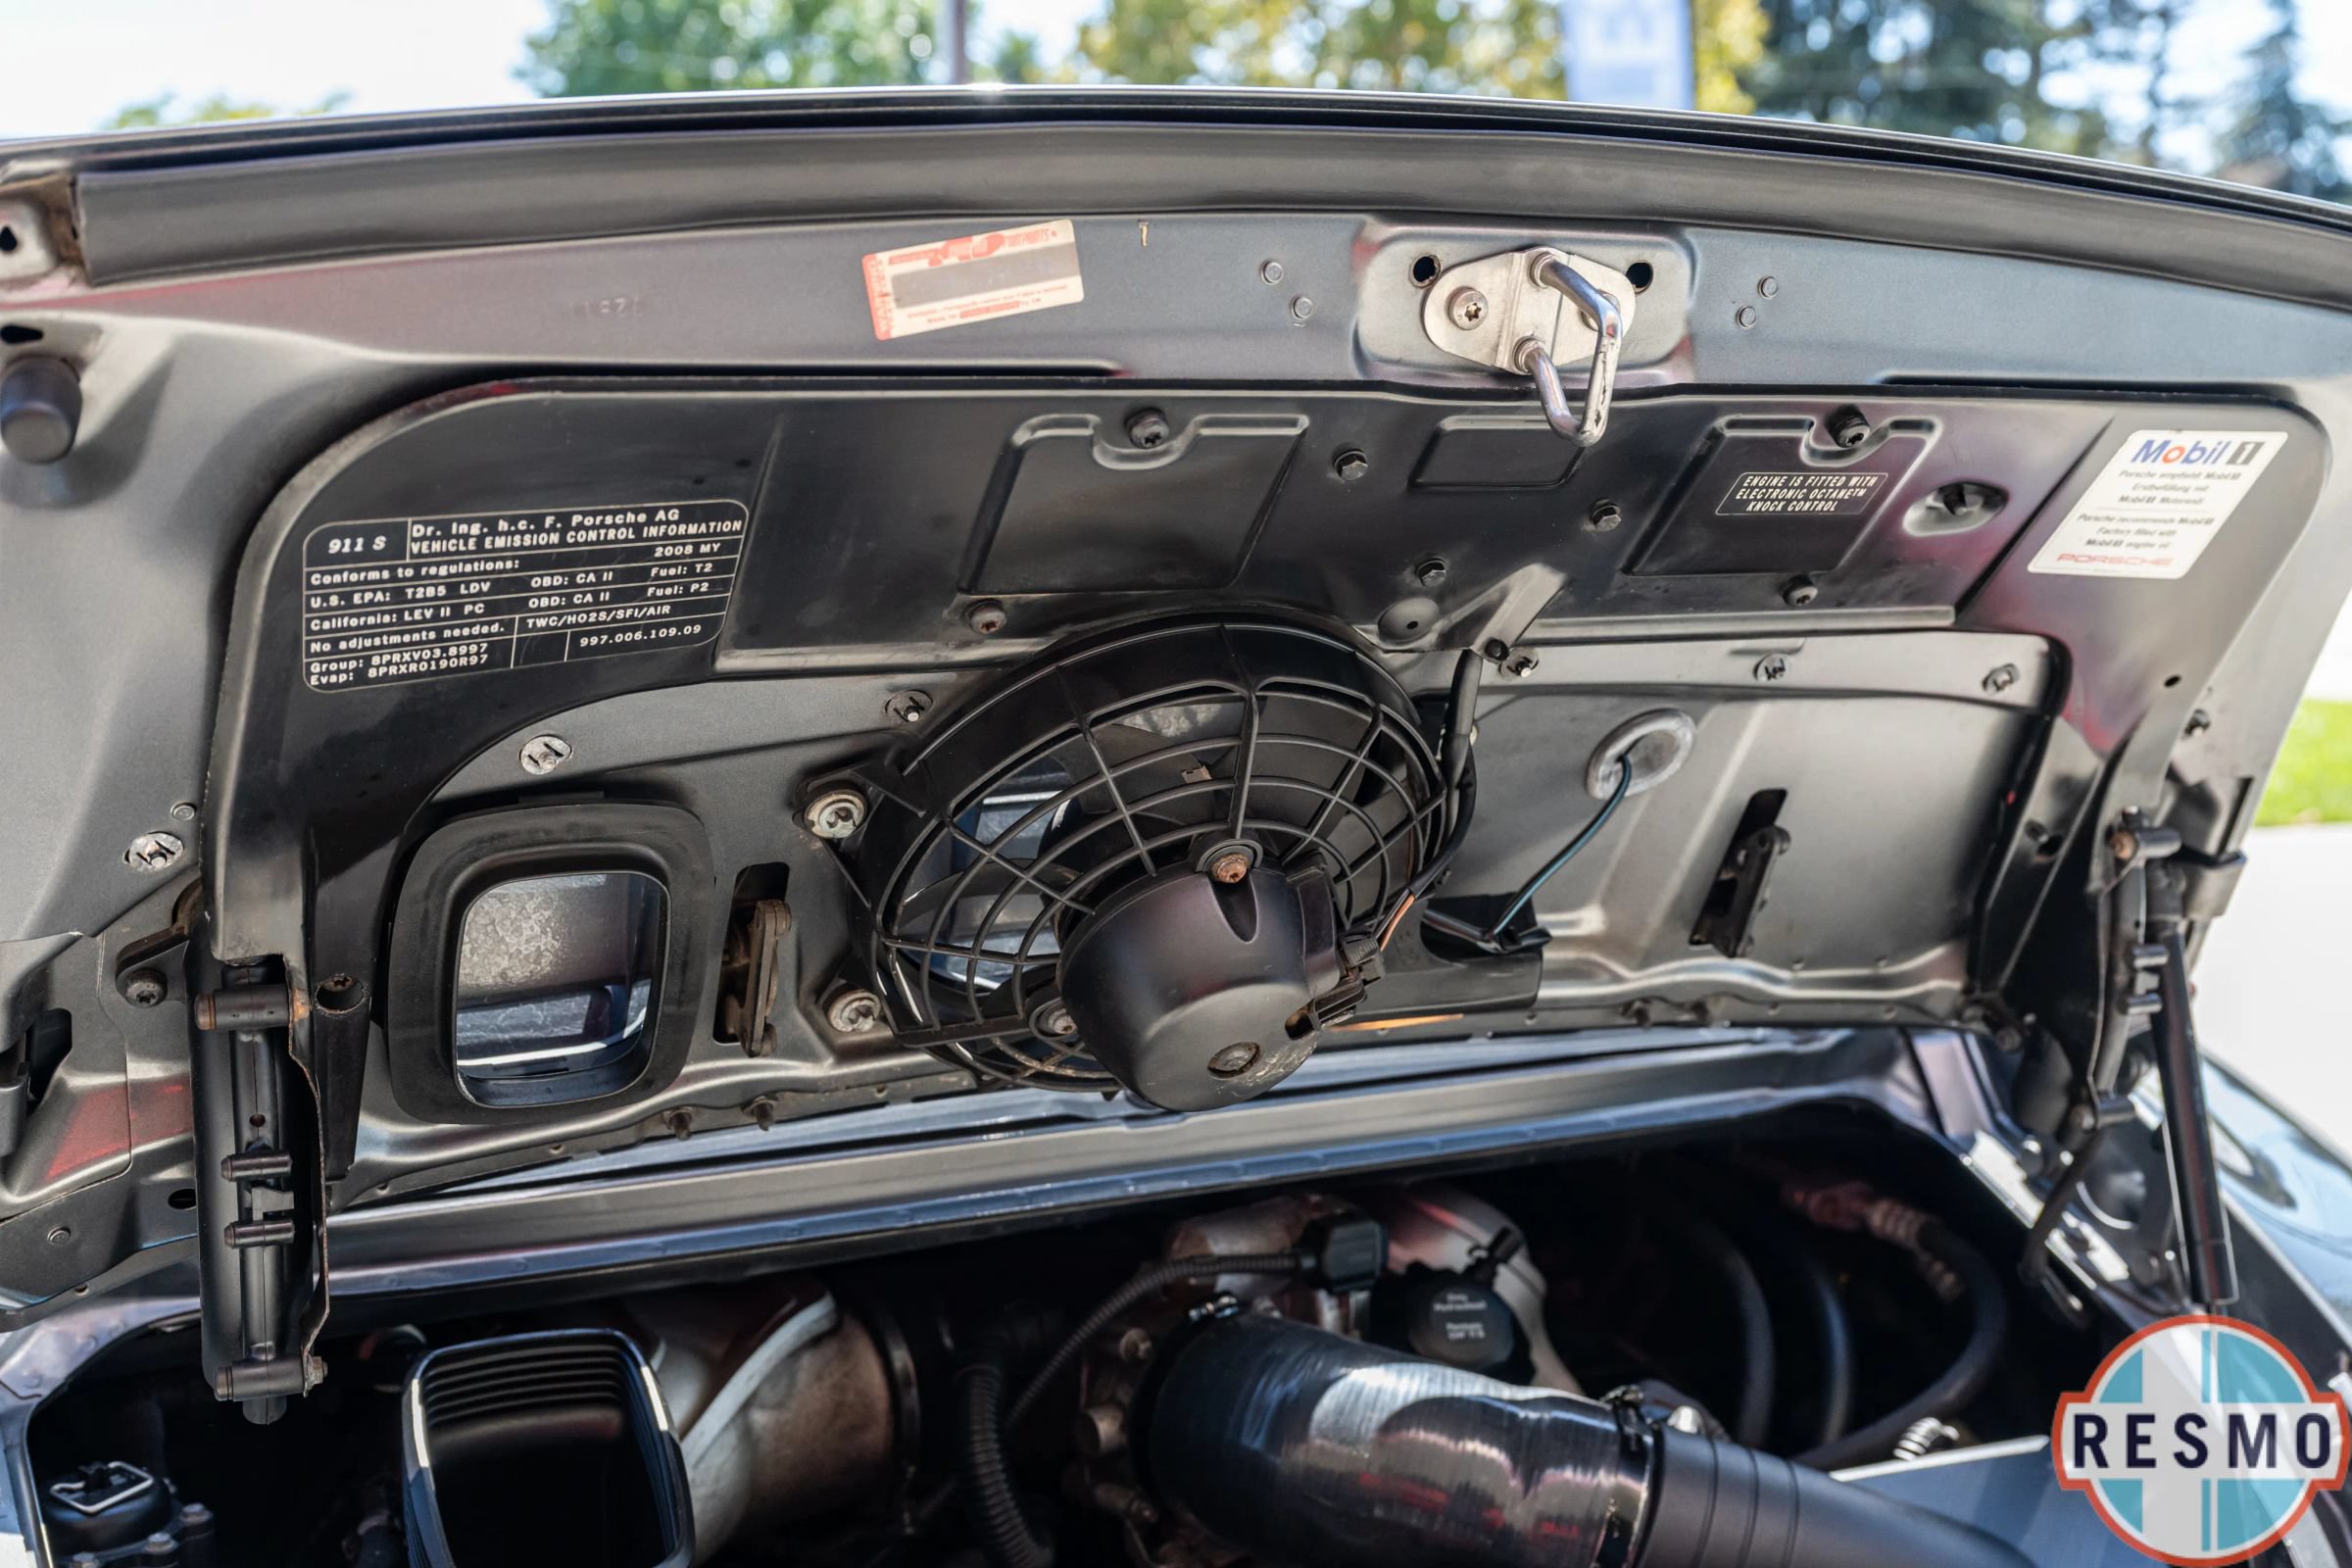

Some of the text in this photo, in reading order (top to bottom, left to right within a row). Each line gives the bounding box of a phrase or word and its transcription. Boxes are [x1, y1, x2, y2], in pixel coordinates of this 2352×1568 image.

[2131, 439, 2232, 465] Mobil
[1742, 475, 1879, 487] ENGINE IS FITTED WITH
[1736, 489, 1807, 500] ELECTRONIC
[1746, 501, 1838, 512] KNOCK CONTROL
[412, 509, 680, 537] Dr. Ing. h.c. F. Porsche AG
[328, 535, 387, 554] 911 S
[411, 520, 743, 555] VEHICLE EMISSION CONTROL INFORMATION
[654, 542, 721, 558] 2008 MY
[2056, 553, 2174, 565] PORSCHE
[311, 560, 520, 585] Conforms to regulations:
[530, 571, 613, 588] OBD: CA II
[651, 563, 713, 577] Fuel: T2
[311, 581, 491, 609] U.S. EPA: T2B5 LDV
[647, 582, 710, 597] Fuel: P2
[528, 591, 611, 609] OBD: CA II
[310, 613, 398, 631] California:
[404, 608, 433, 621] LEV
[464, 603, 485, 615] PC
[526, 605, 671, 628] TWC/HO2S/SFI/AIR
[310, 622, 505, 654] No adjustments needed.
[579, 624, 702, 647] 997.006.109.09
[310, 642, 489, 674] Group: 8PRXV03.8997
[310, 670, 354, 686] Evap:
